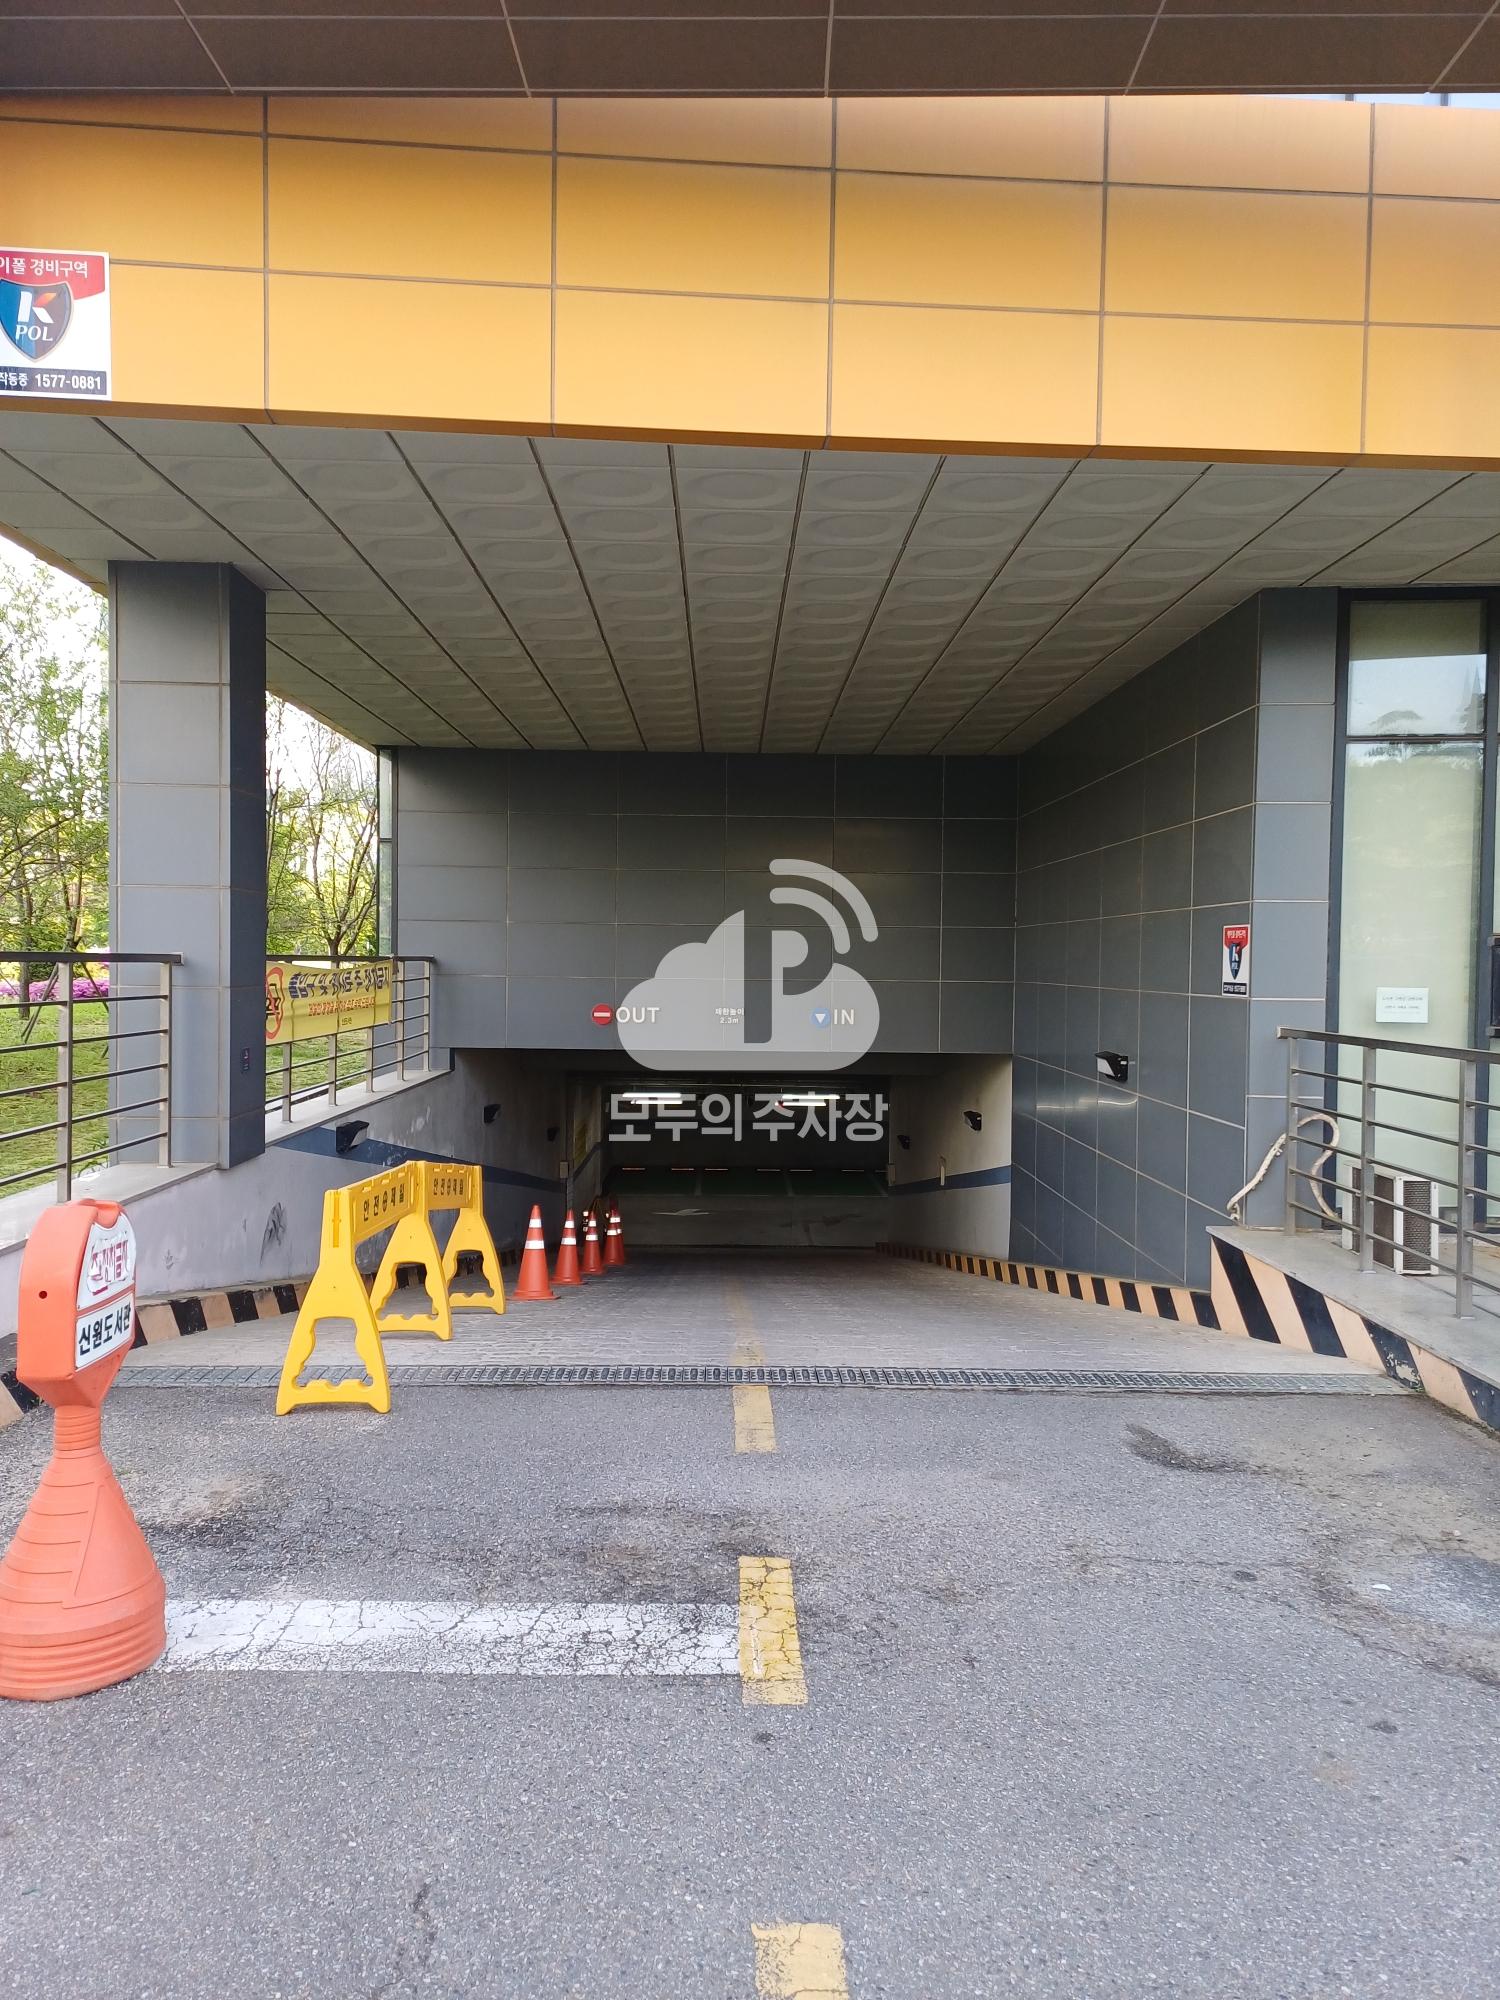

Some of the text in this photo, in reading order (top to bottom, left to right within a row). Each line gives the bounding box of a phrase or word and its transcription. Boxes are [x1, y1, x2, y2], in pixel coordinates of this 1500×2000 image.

[30, 258, 88, 279] 경비구역
[17, 290, 57, 324] K
[15, 324, 54, 342] POL
[34, 373, 102, 390] 1577-0881
[288, 972, 317, 999] 출입구
[615, 1006, 661, 1024] OUT
[834, 1008, 855, 1025] IN
[78, 1302, 131, 1356] 신원도서관
